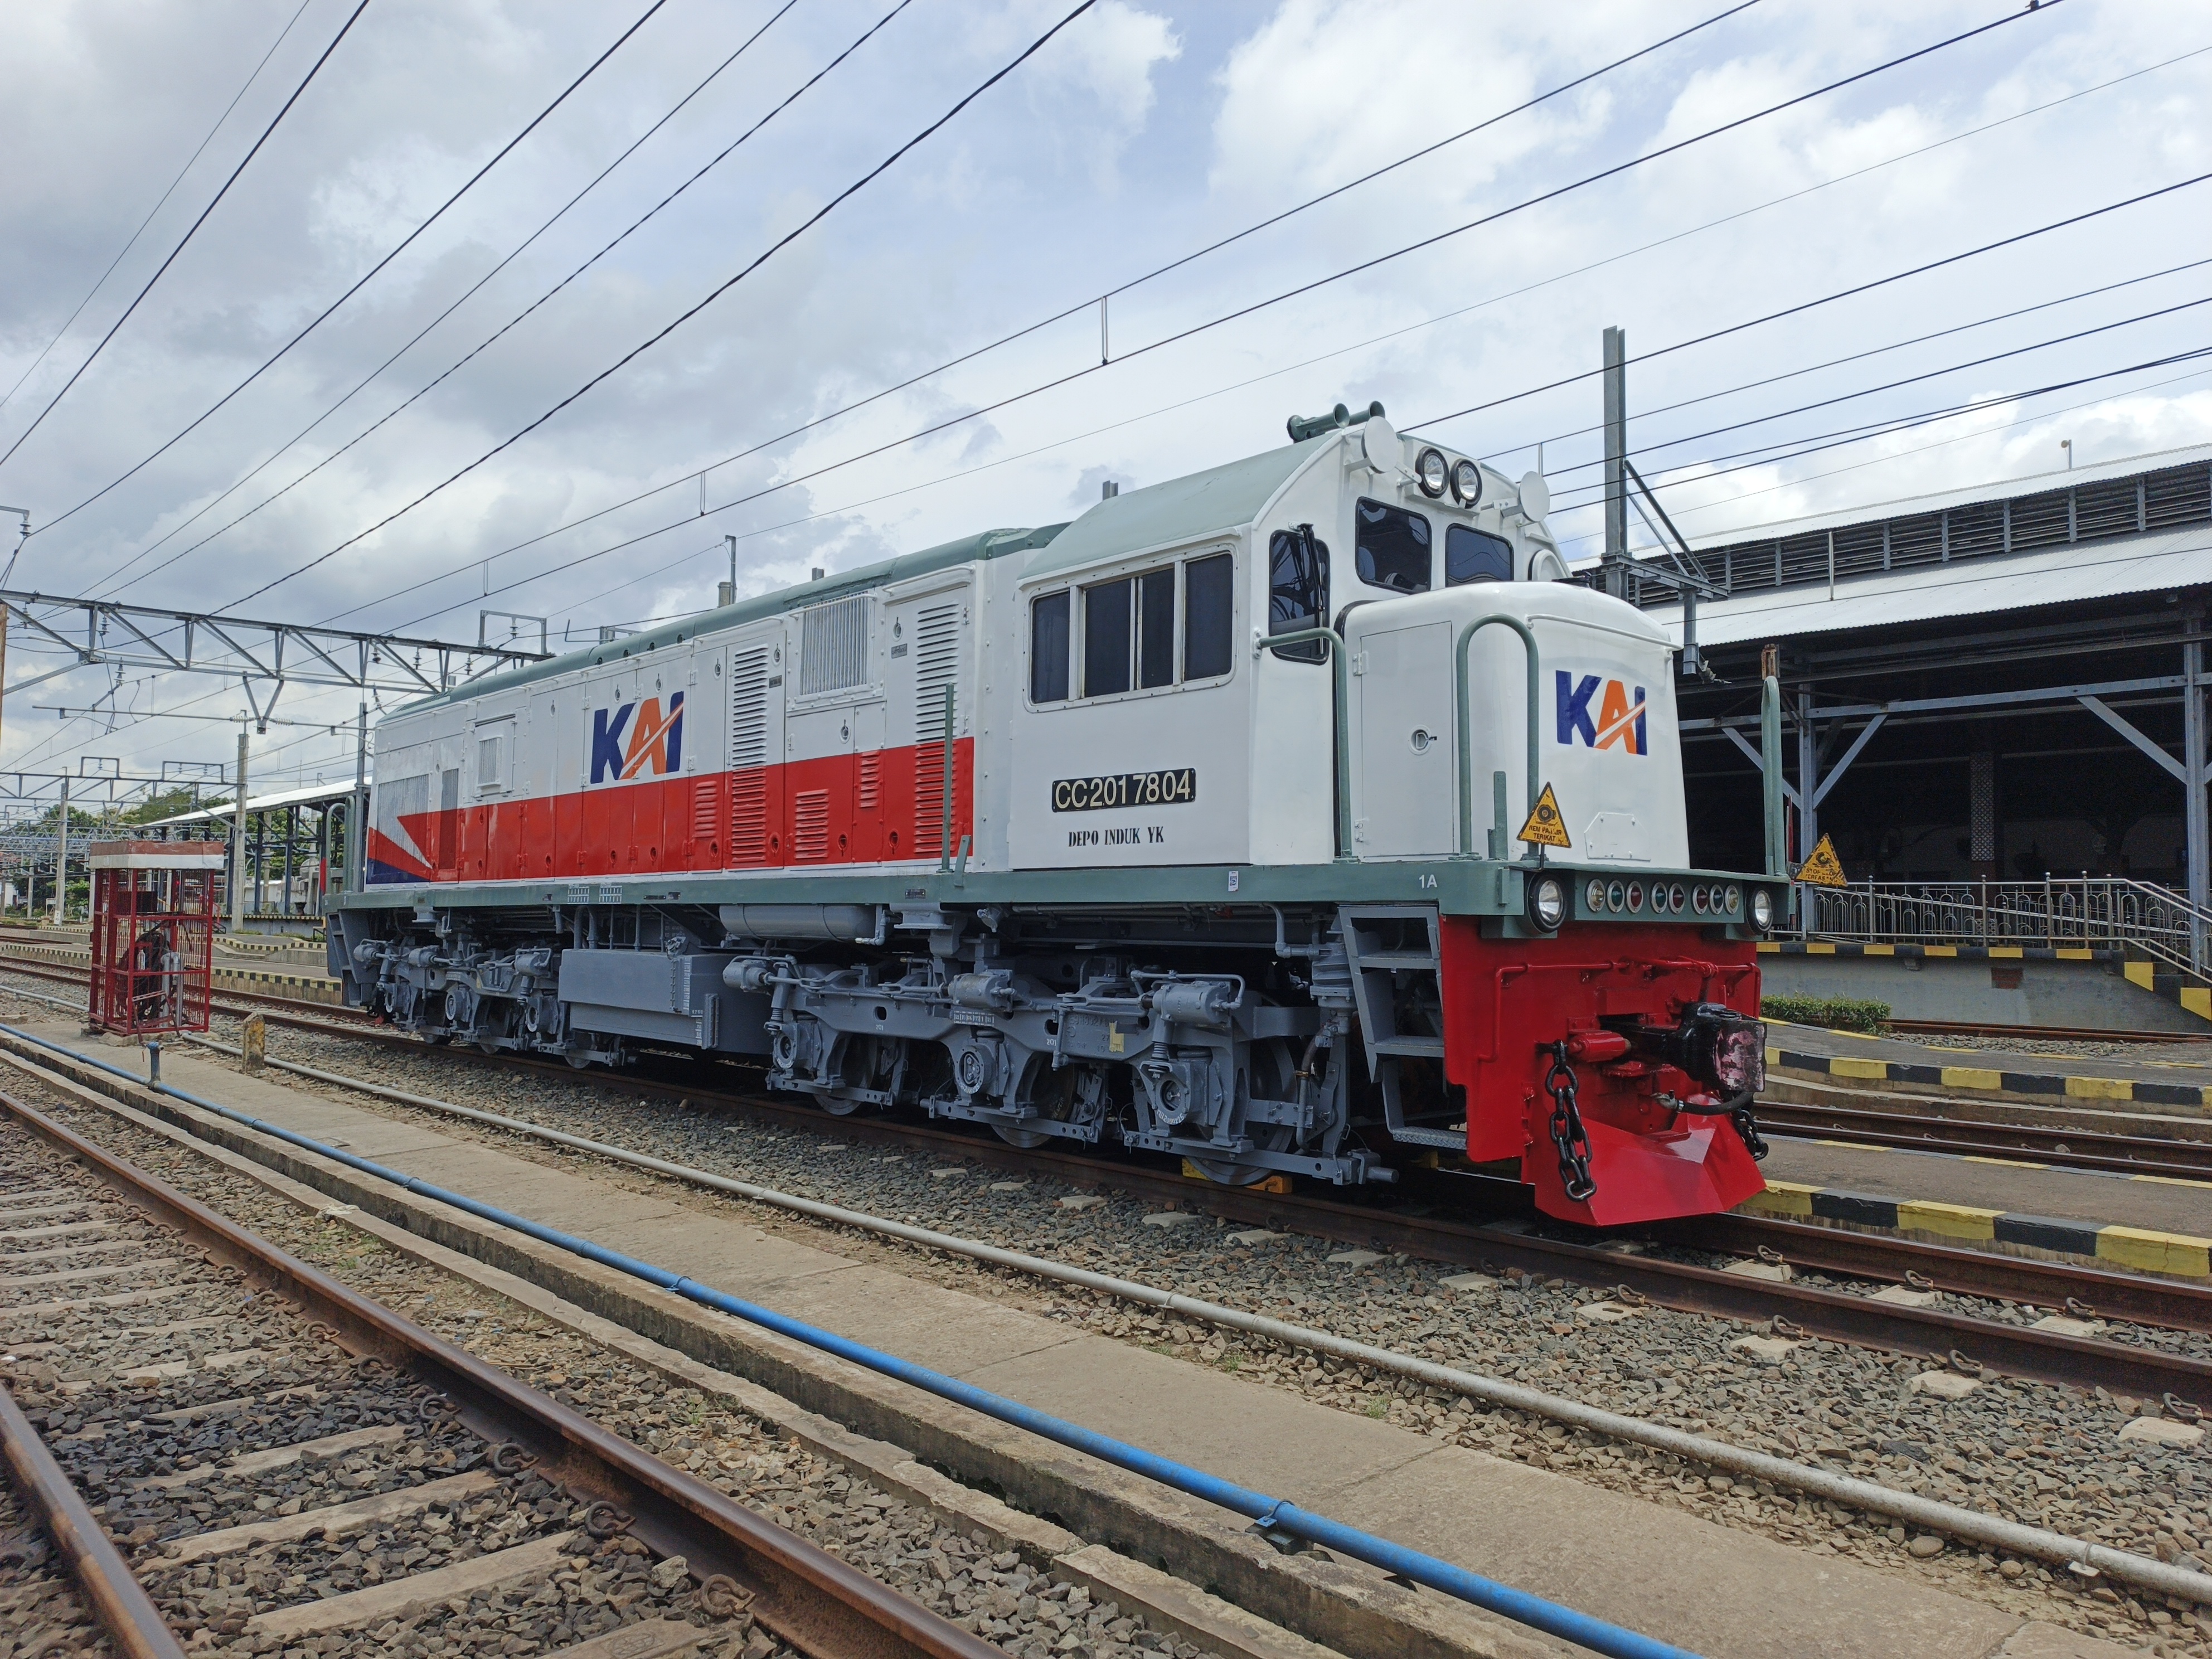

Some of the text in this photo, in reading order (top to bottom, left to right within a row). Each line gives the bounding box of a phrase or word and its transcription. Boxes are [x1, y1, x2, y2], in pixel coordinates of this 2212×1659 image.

[1555, 670, 1648, 755] KAI
[590, 691, 685, 784] KAI
[1069, 826, 1165, 847] DEPO INDUK YK
[1534, 833, 1556, 841] TERIKAT
[1419, 874, 1438, 889] 1A
